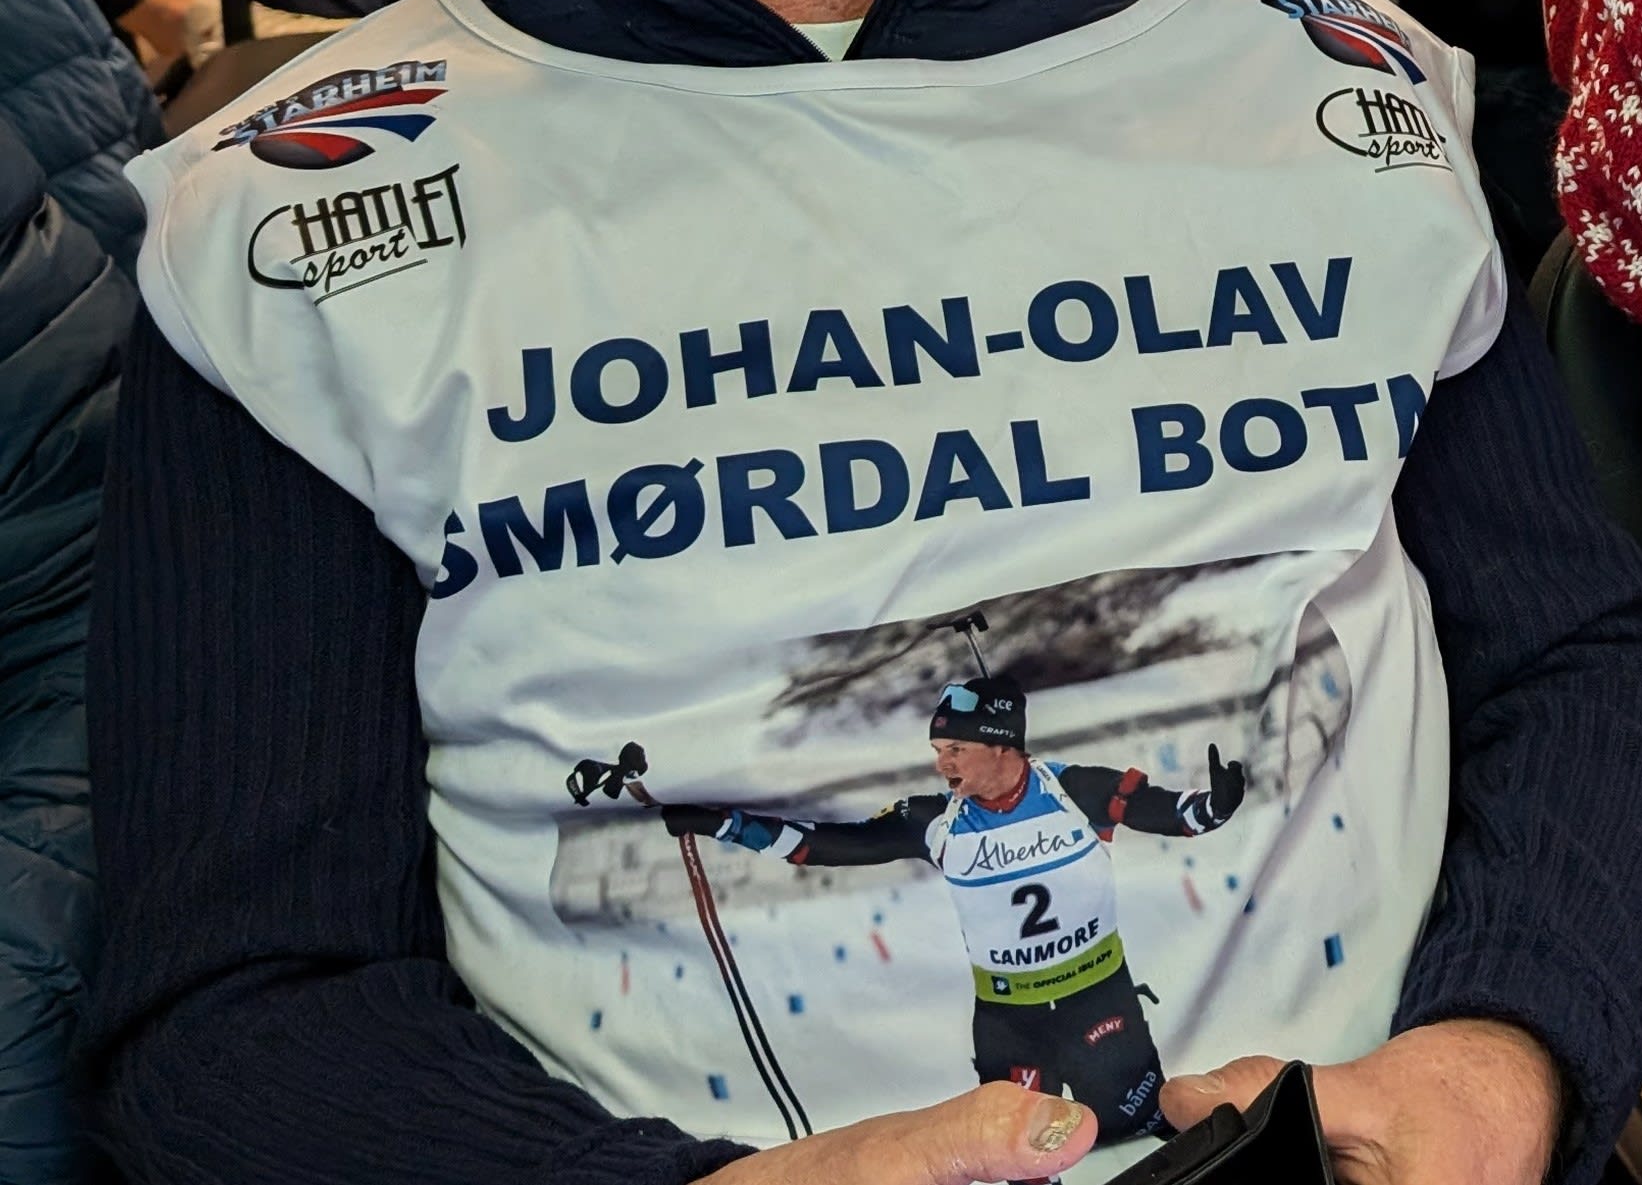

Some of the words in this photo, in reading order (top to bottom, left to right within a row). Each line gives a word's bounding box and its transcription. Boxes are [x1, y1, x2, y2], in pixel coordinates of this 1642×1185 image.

[1368, 135, 1440, 166] sport
[303, 227, 410, 292] sport
[487, 257, 1353, 443] JOHAN-OLAV
[430, 420, 1091, 600] SMØRDAL
[961, 831, 1074, 876] Alberta
[1011, 883, 1061, 940] 2
[989, 917, 1100, 967] CANMORE
[1089, 1018, 1123, 1043] MENY
